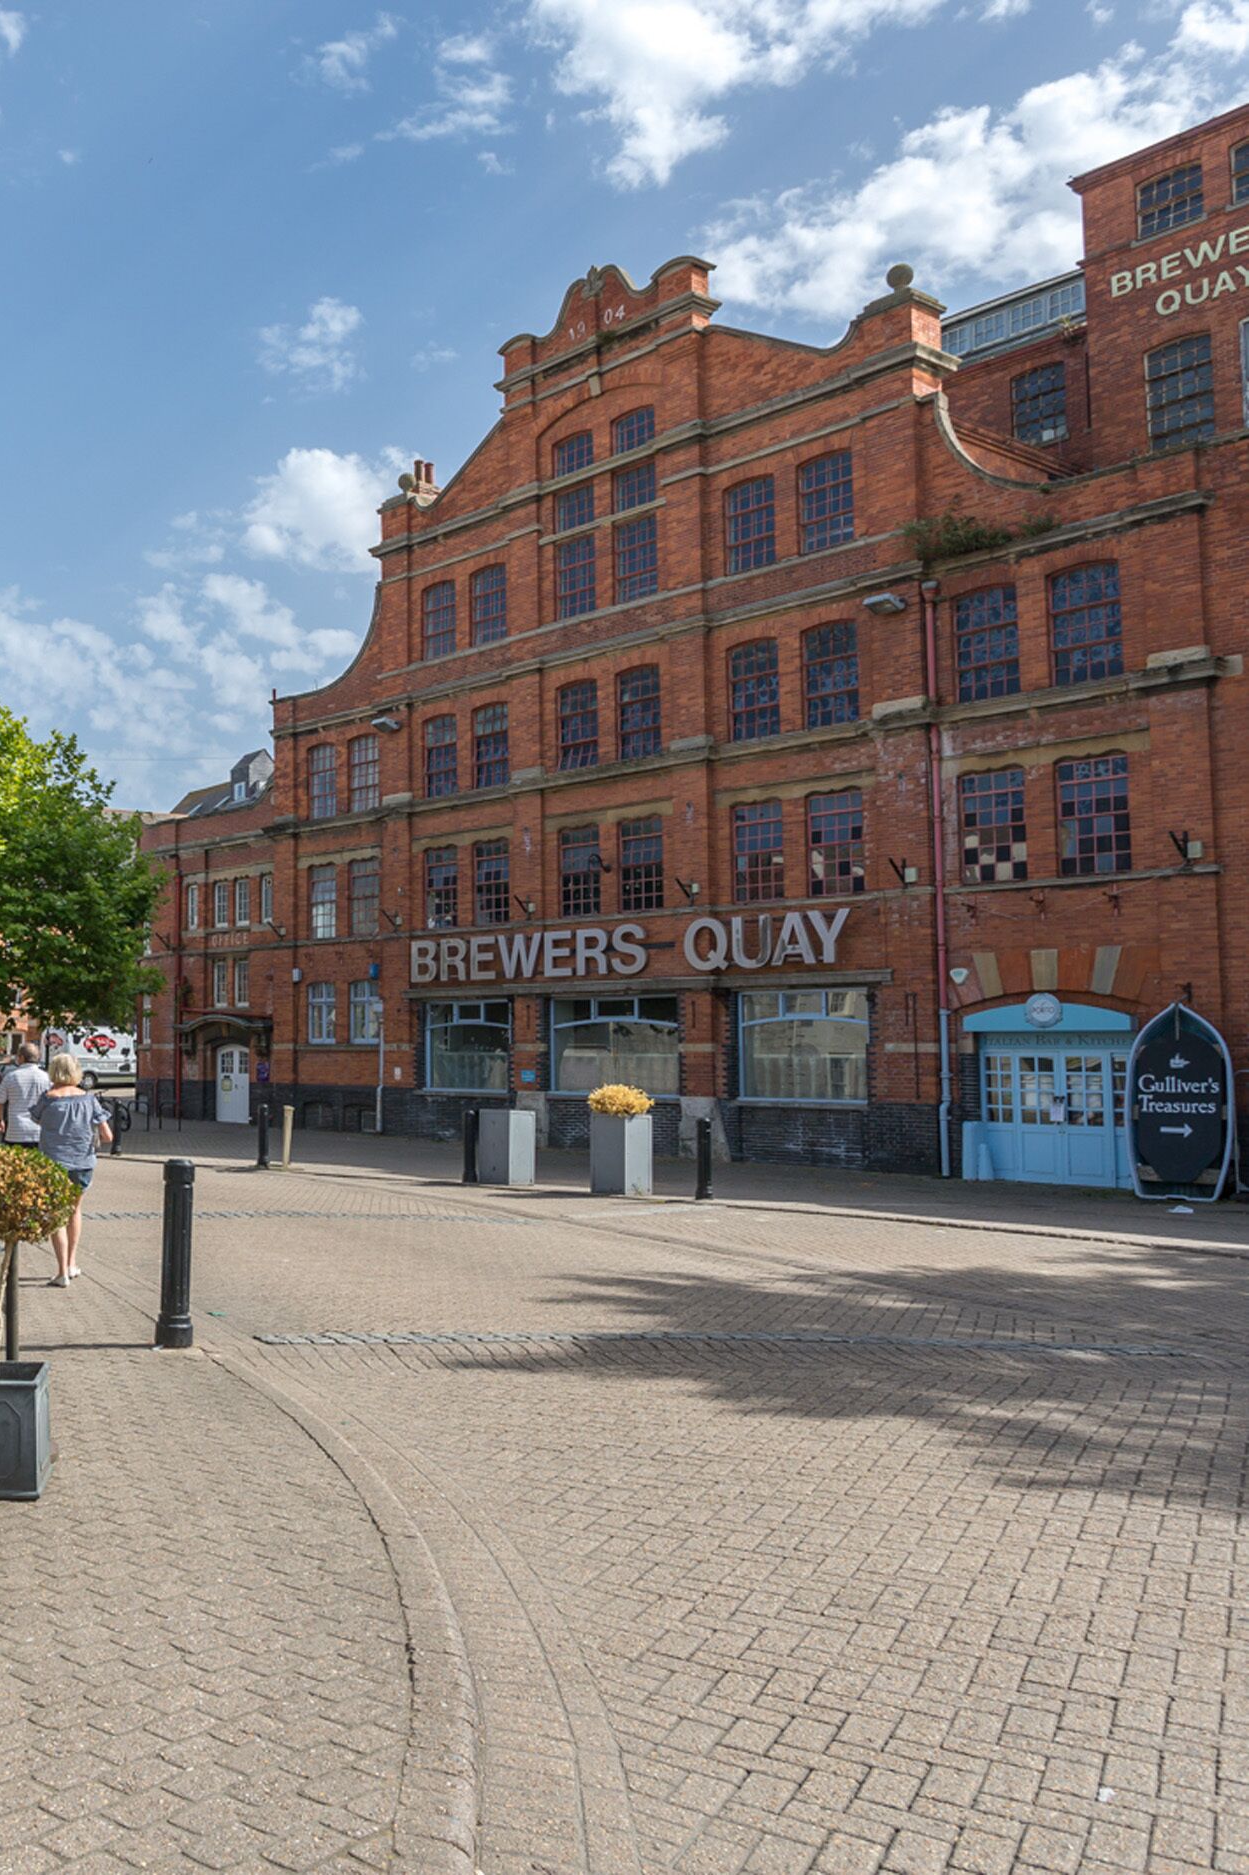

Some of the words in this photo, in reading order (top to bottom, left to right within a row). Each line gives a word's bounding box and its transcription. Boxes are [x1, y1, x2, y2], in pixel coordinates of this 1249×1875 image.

[211, 932, 250, 947] OFFICE
[410, 923, 648, 983] BREWERS
[683, 908, 849, 971] QUAY
[1036, 1034, 1059, 1045] BAR
[1138, 1074, 1220, 1093] Gulliver's
[1138, 1094, 1216, 1113] Treasures
